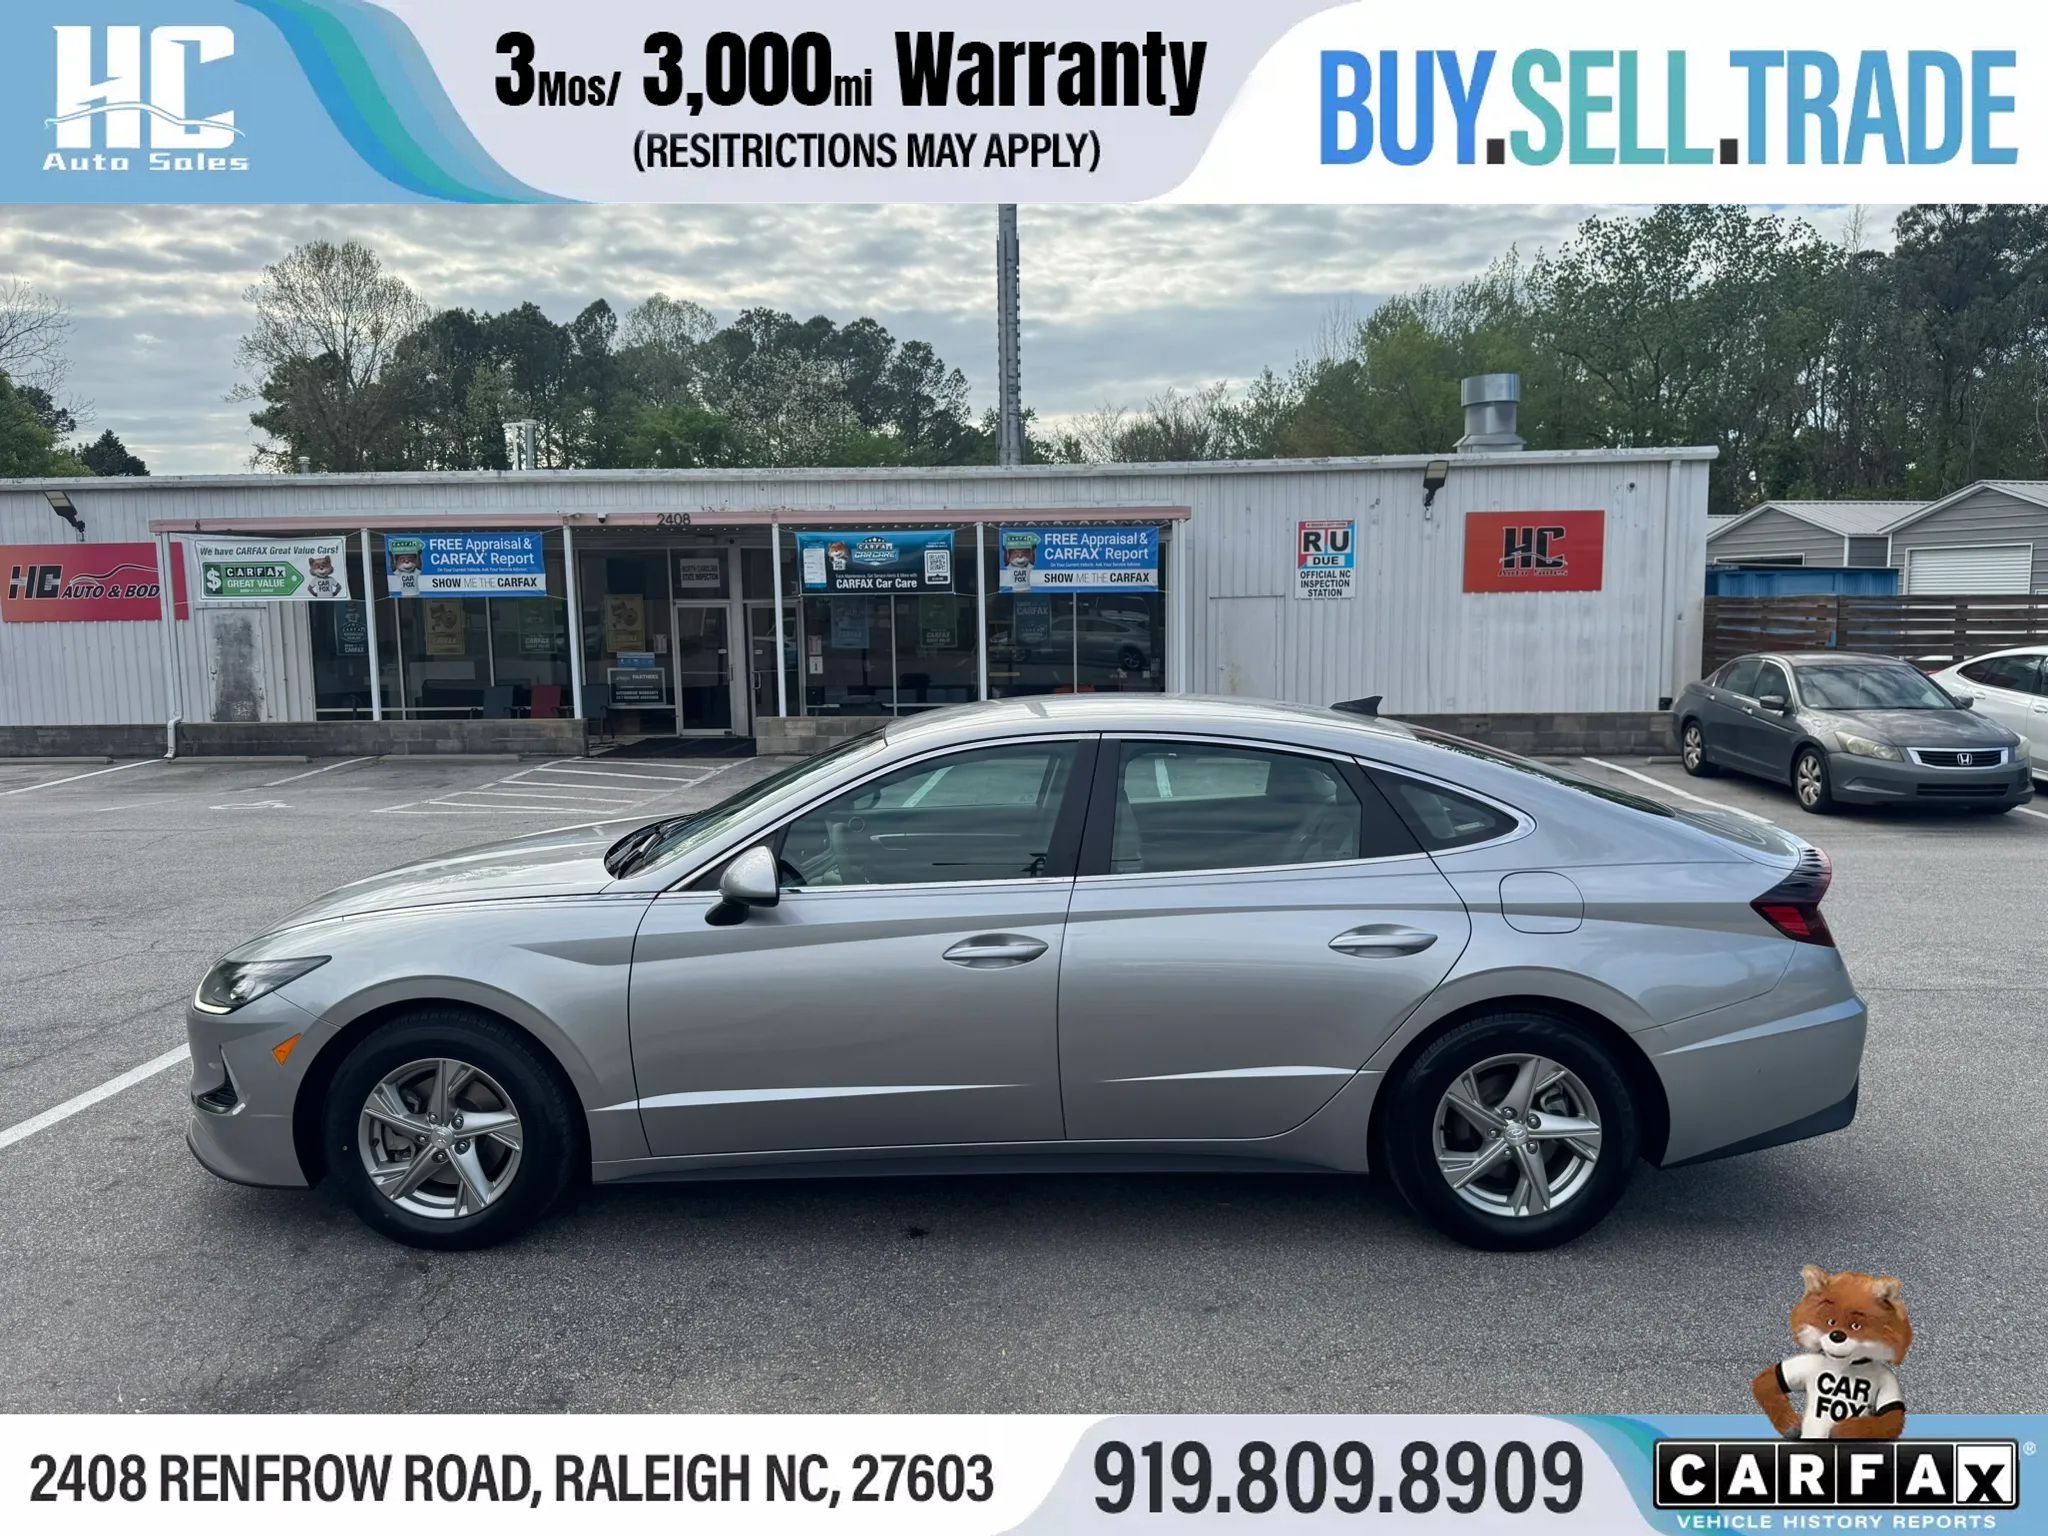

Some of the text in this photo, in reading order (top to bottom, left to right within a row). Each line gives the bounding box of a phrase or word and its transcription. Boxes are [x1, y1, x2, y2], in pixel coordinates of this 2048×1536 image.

[657, 512, 691, 525] 2408
[429, 538, 532, 554] FREE Appraisal &
[1044, 532, 1148, 549] FREE Appraisal &
[200, 545, 339, 556] We have CARFAX Great Value Cars!
[1502, 525, 1567, 569] HC
[490, 553, 535, 566] Report
[1105, 547, 1149, 561] Report
[1312, 556, 1339, 565] DUE
[226, 567, 286, 577] CARFAX
[1300, 570, 1351, 579] OFFICIAL NC
[8, 564, 160, 599] HC AUTO & BOD
[227, 579, 285, 588] GREAT VALUE
[432, 578, 537, 588] SHOW ME THE CARFAX
[836, 578, 918, 589] CARFAX Car Care
[1044, 573, 1150, 583] SHOW ME THE CARFAX
[1301, 579, 1350, 588] INSPECTION
[1308, 589, 1342, 597] STATION
